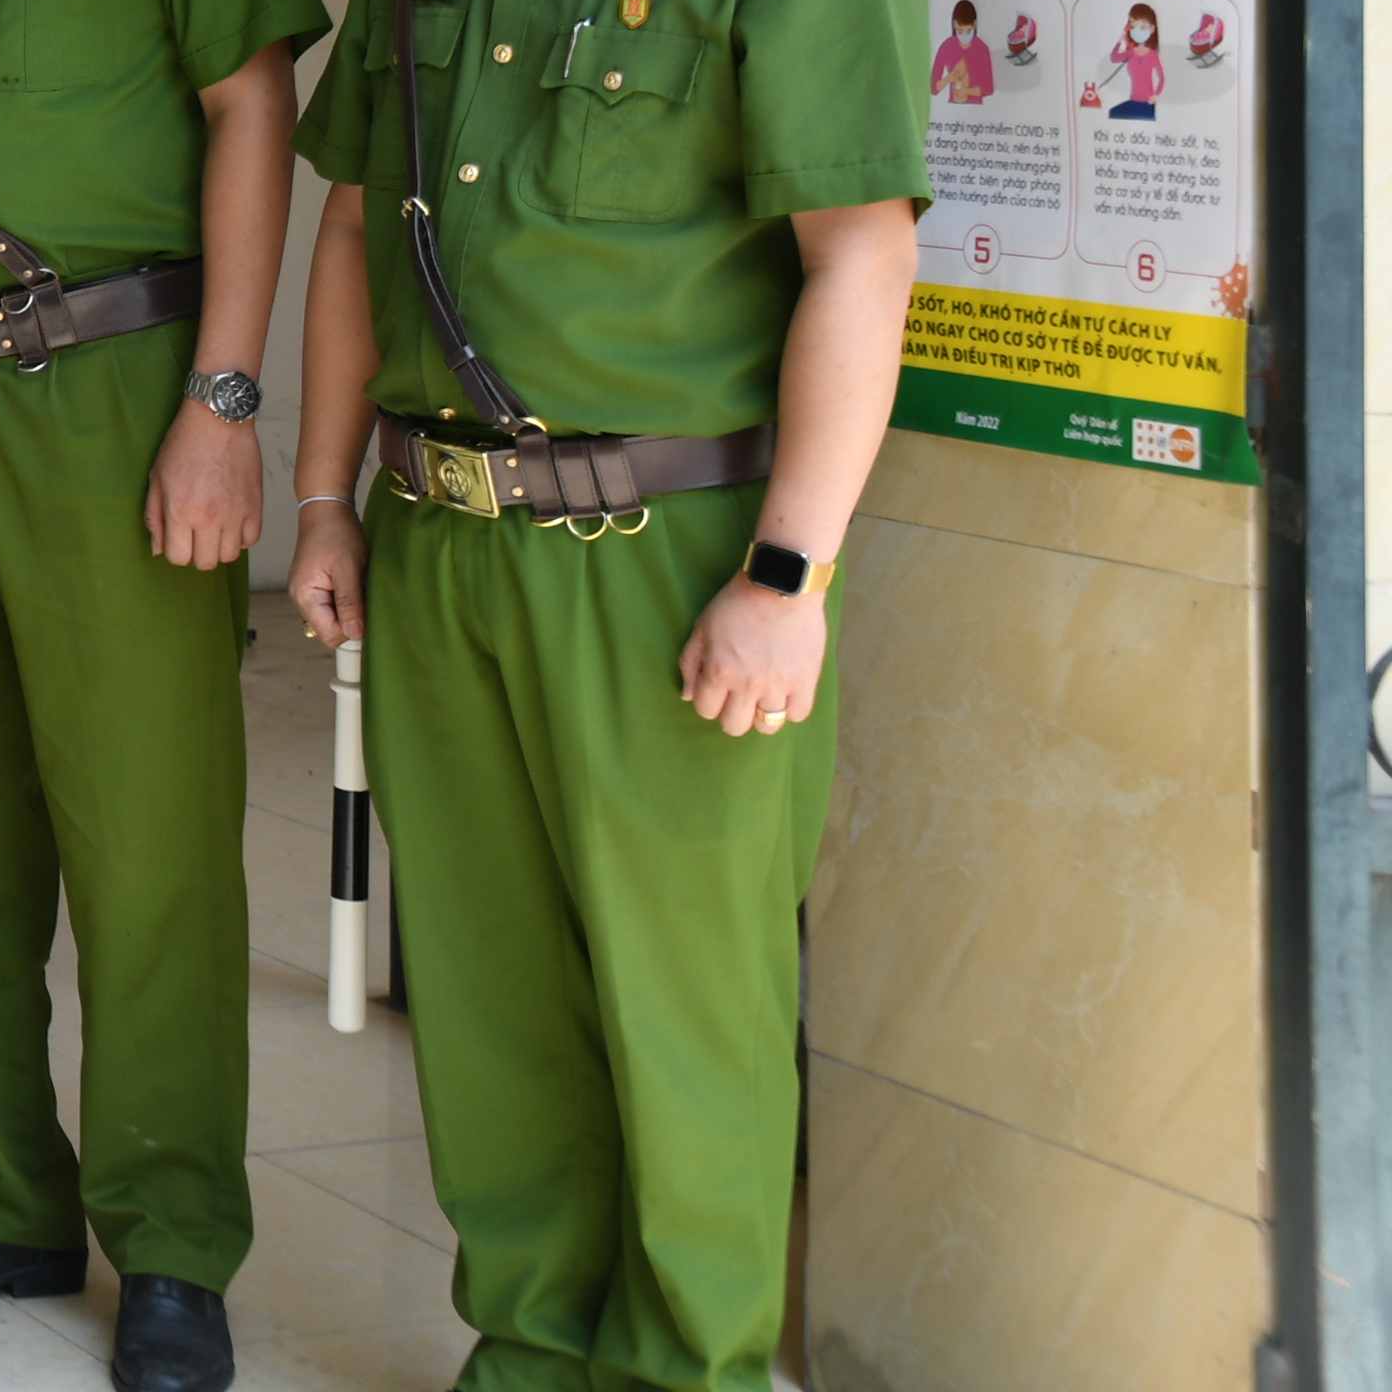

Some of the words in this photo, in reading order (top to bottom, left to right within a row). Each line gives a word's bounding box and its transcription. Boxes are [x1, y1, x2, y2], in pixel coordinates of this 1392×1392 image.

[974, 237, 991, 265] 5
[1137, 253, 1156, 282] 6
[917, 293, 948, 315] SỐT,
[951, 300, 977, 318] HO,
[980, 302, 1011, 321] KHÓ
[1014, 305, 1046, 325] THỞ
[1108, 318, 1150, 338] CÁCH
[1155, 326, 1172, 341] LY
[926, 321, 965, 339] NGAY
[968, 326, 999, 344] CHO
[1003, 330, 1023, 346] CƠ
[1026, 330, 1047, 350] SỞ
[1049, 337, 1058, 351] Y
[1061, 335, 1080, 354] TẾ
[1107, 344, 1153, 367] ĐƯỢC
[1157, 350, 1179, 367] TƯ
[930, 343, 950, 360] VÀ
[990, 353, 1013, 374] TRỊ
[1017, 357, 1040, 376] KỊP
[1043, 360, 1081, 379] THỜI
[955, 411, 976, 427] Năm
[977, 416, 1000, 430] 2022
